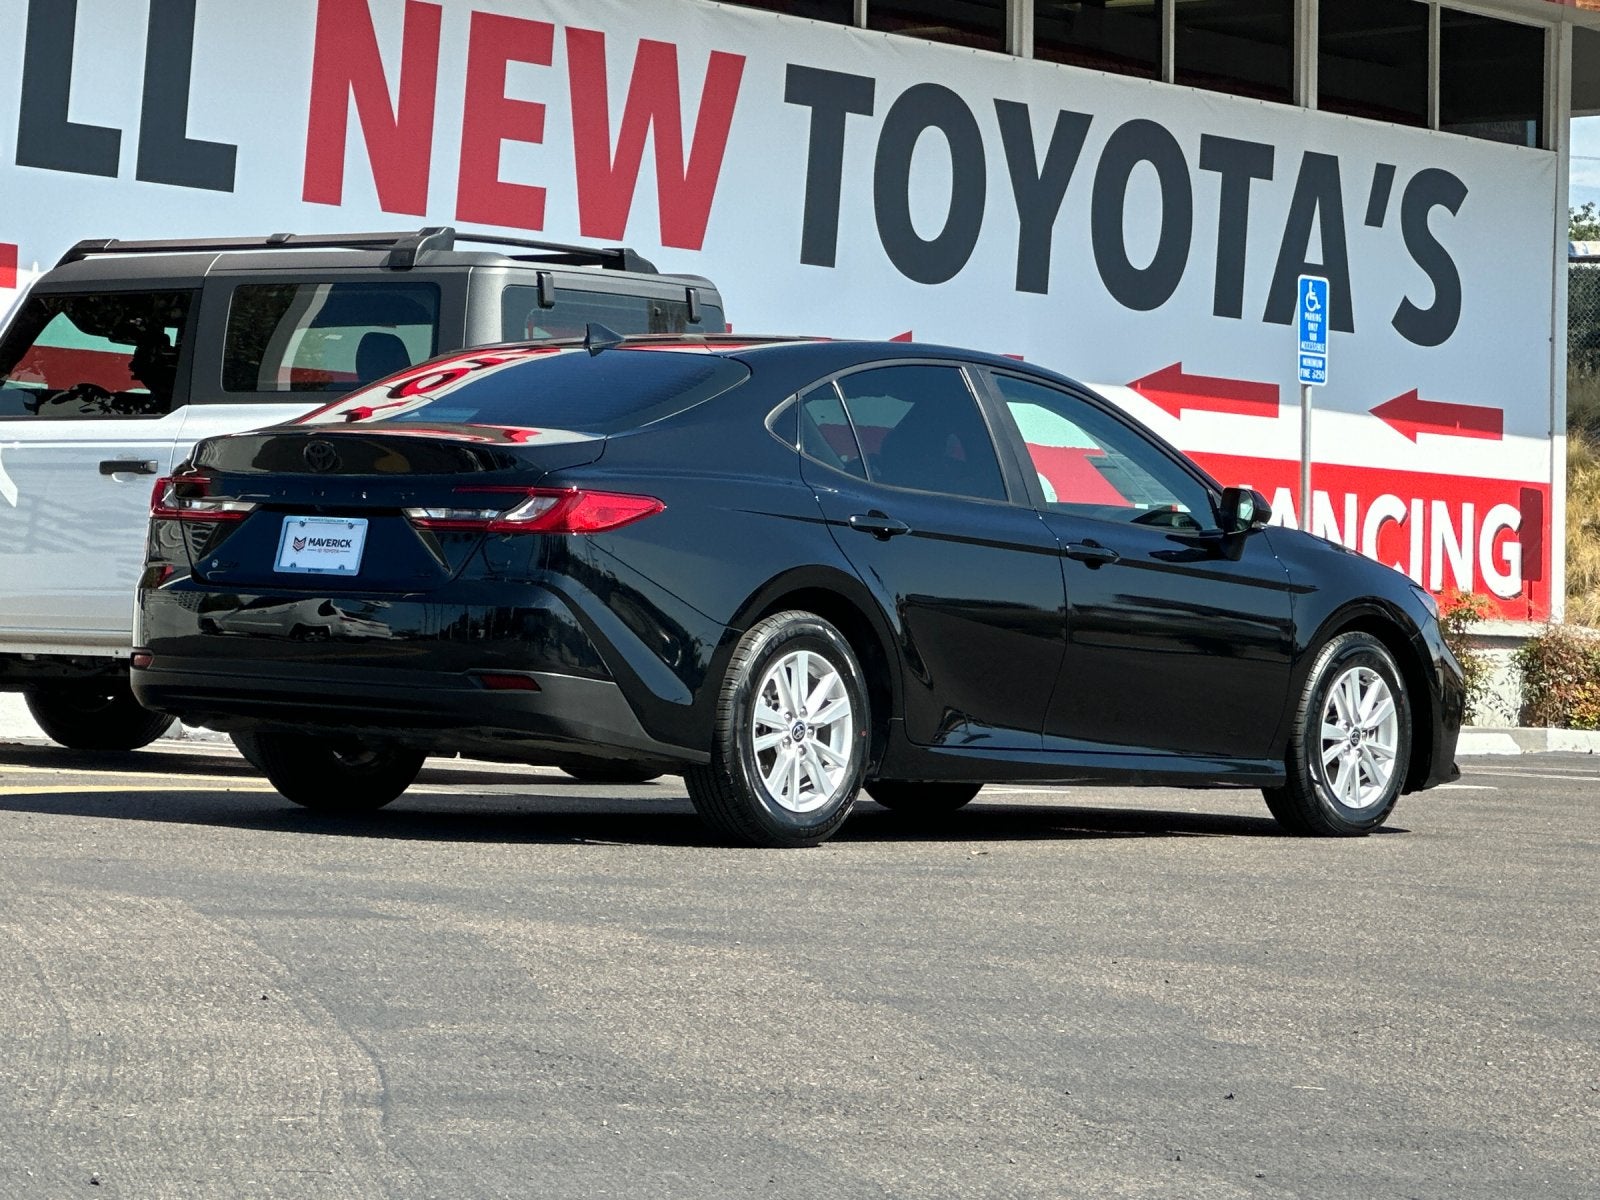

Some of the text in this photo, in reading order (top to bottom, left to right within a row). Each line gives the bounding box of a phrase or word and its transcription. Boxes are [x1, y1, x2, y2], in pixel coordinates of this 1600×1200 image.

[302, 0, 746, 251] NEW
[785, 64, 1469, 347] TOYOTA'S
[1304, 312, 1322, 322] PARKING
[308, 538, 352, 548] MAVERICK
[1238, 485, 1524, 600] NCING
